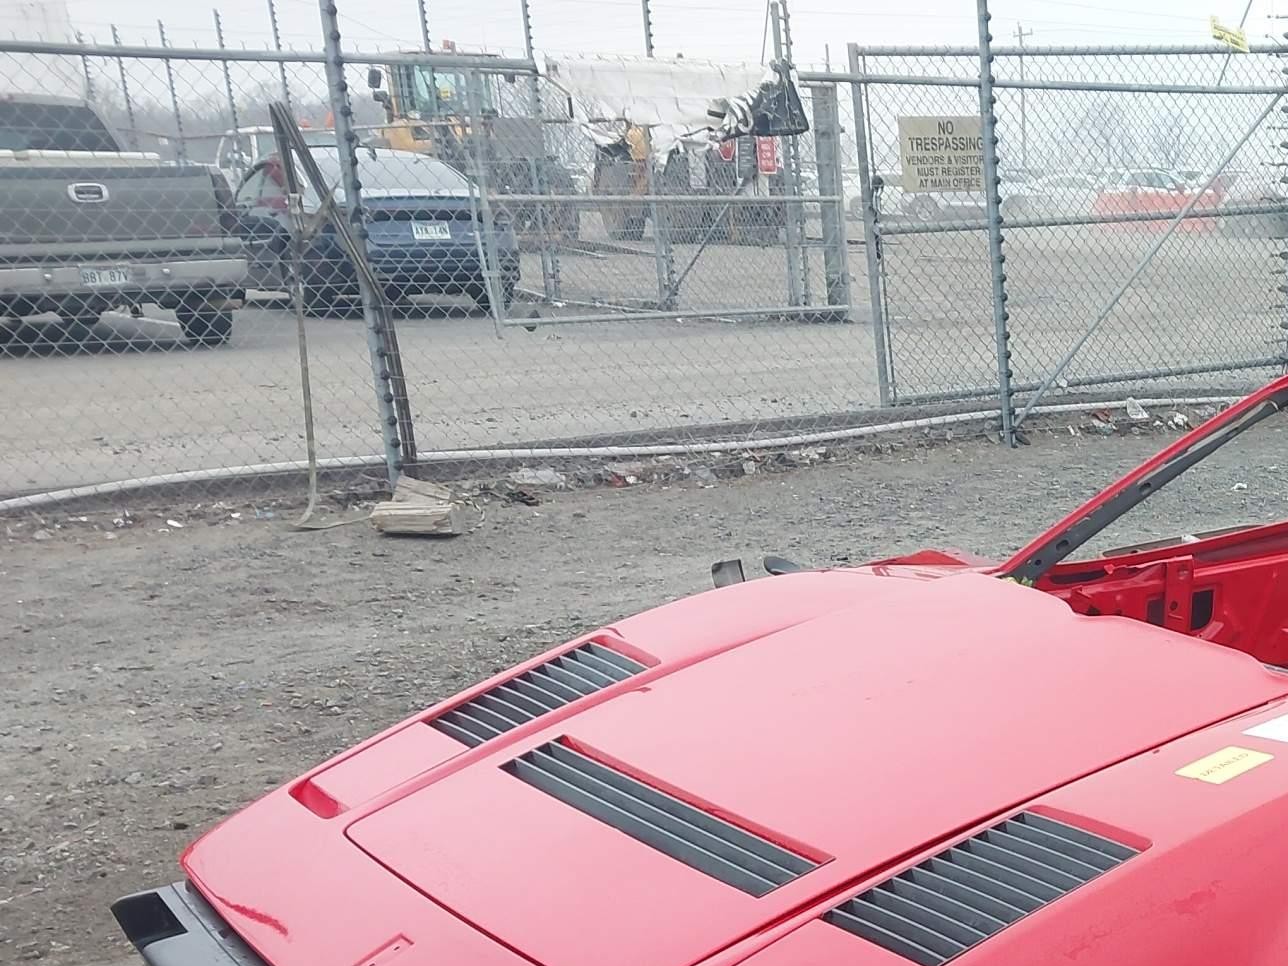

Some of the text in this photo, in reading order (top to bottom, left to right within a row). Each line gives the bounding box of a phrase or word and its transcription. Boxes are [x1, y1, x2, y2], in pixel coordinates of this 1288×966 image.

[938, 120, 954, 135] NO
[908, 136, 984, 151] TRESPASSING
[906, 155, 945, 165] VENDORS
[954, 155, 984, 165] VISITOR
[917, 166, 980, 176] MUST REGISTER
[919, 178, 981, 188] AT MAIN OFFICE
